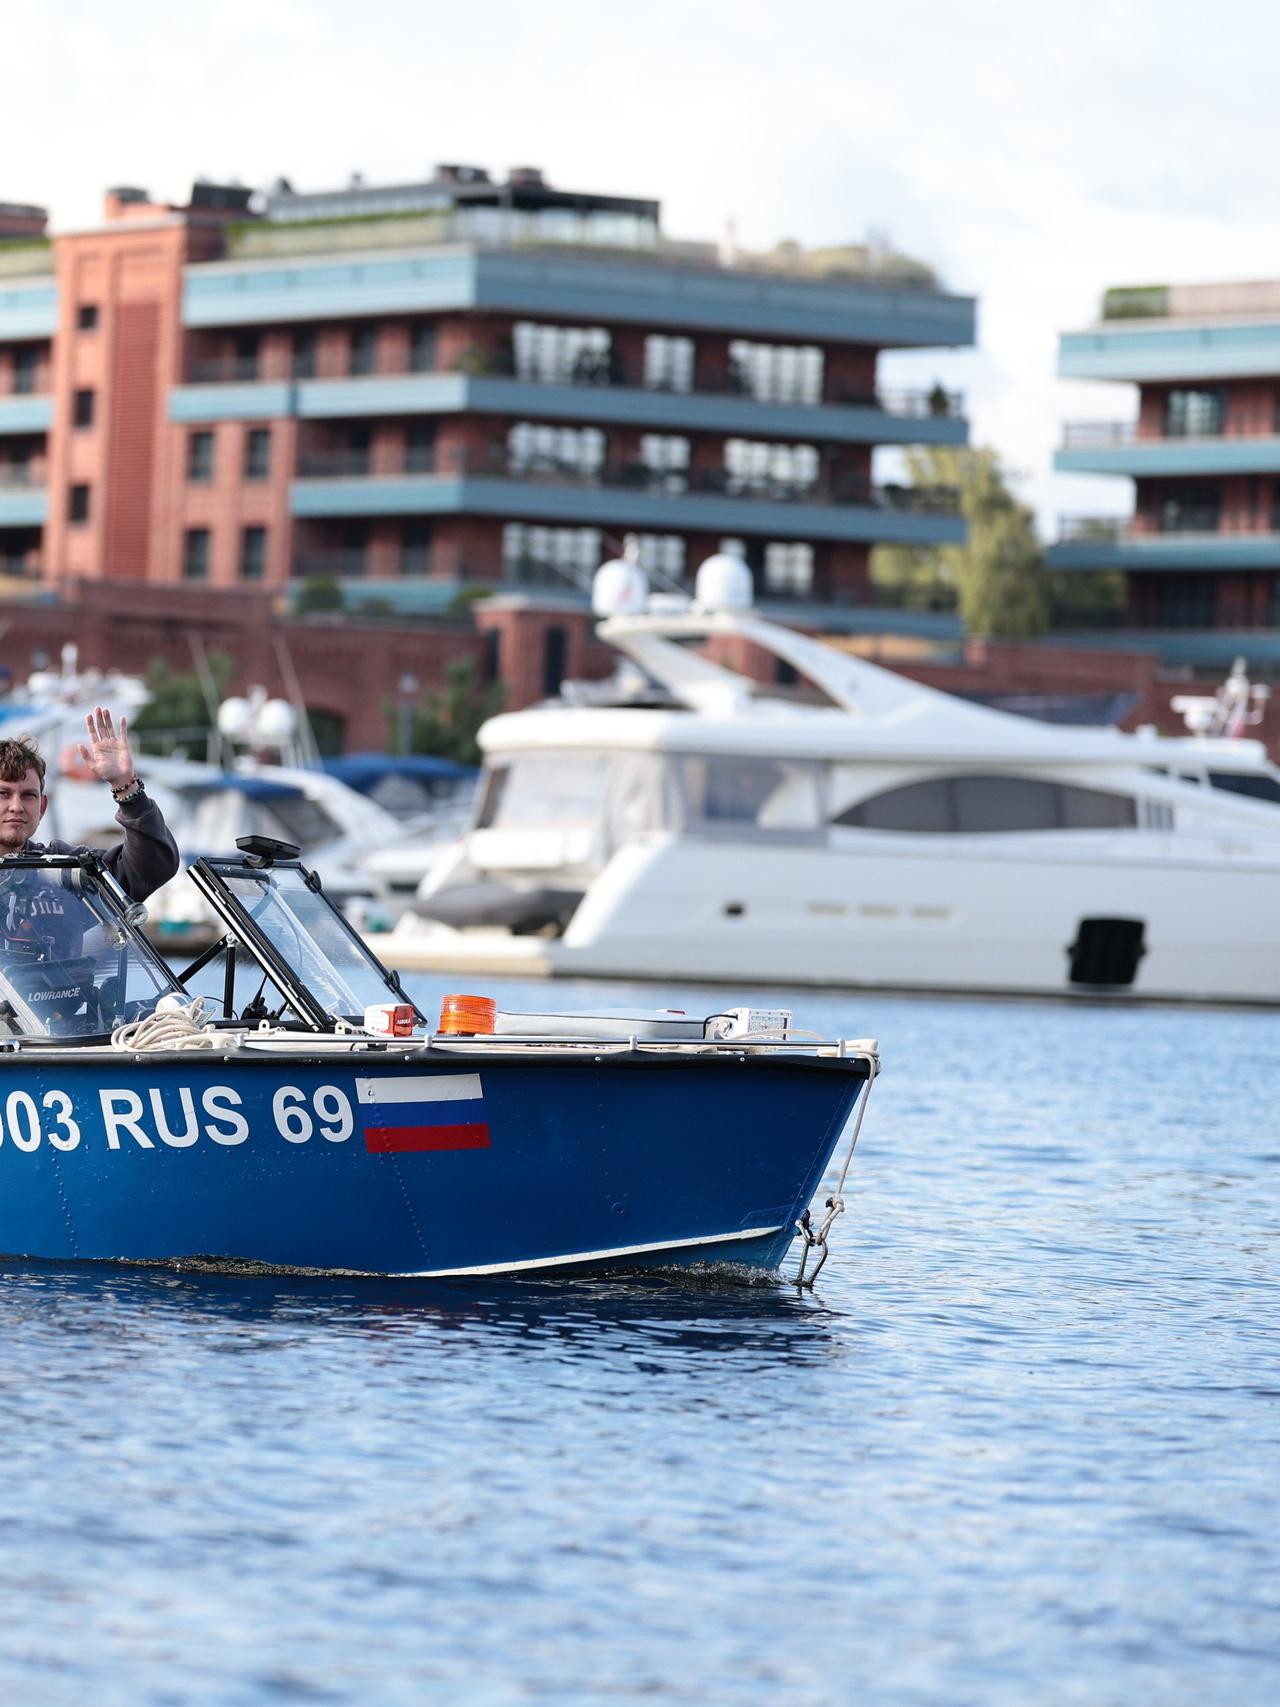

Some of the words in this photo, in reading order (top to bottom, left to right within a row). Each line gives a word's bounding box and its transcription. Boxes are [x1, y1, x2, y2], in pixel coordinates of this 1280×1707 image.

[28, 987, 81, 1002] LOWRANCE
[98, 1085, 250, 1149] RUS
[272, 1085, 355, 1144] 69
